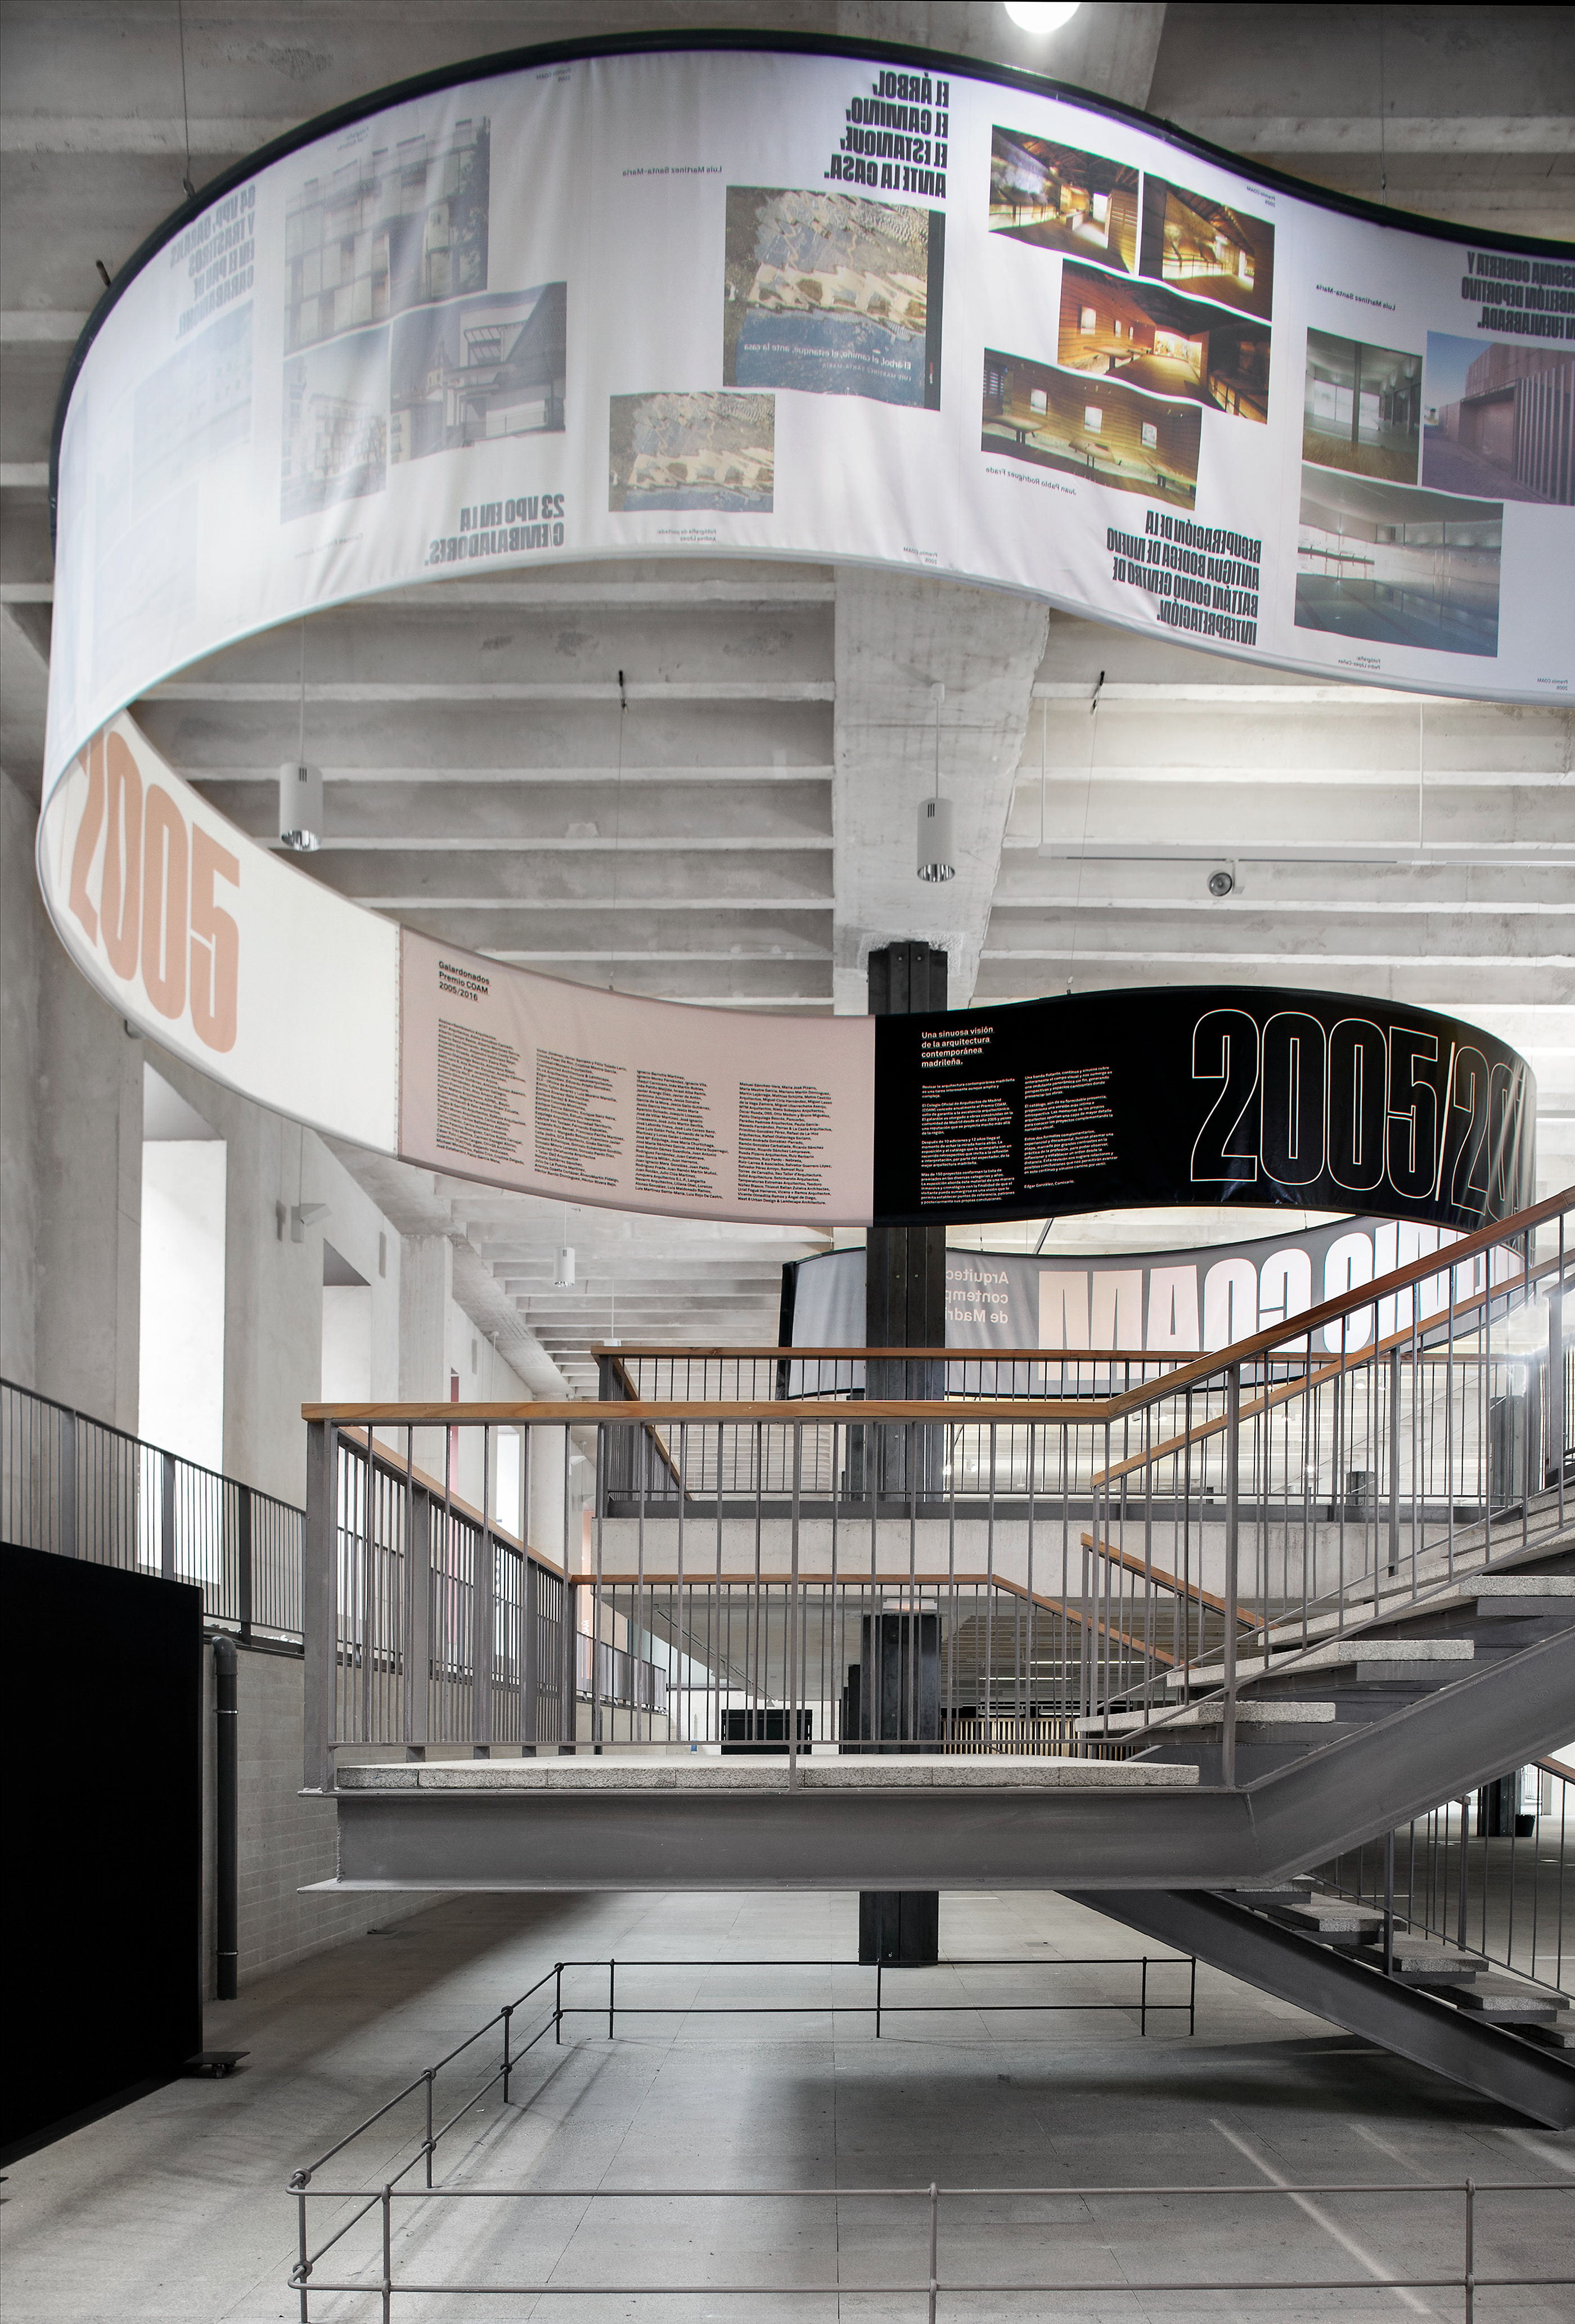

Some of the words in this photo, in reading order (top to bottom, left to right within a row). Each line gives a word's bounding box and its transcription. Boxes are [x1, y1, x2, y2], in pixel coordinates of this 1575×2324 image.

[439, 961, 490, 985] Galardonados
[439, 972, 465, 987] Premio
[466, 981, 488, 995] COAM
[439, 982, 478, 1001] 2005/2016
[970, 1026, 993, 1035] visión
[942, 1036, 990, 1048] arquitectura
[921, 1048, 982, 1058] contemporánea
[921, 1059, 963, 1068] madrileña.
